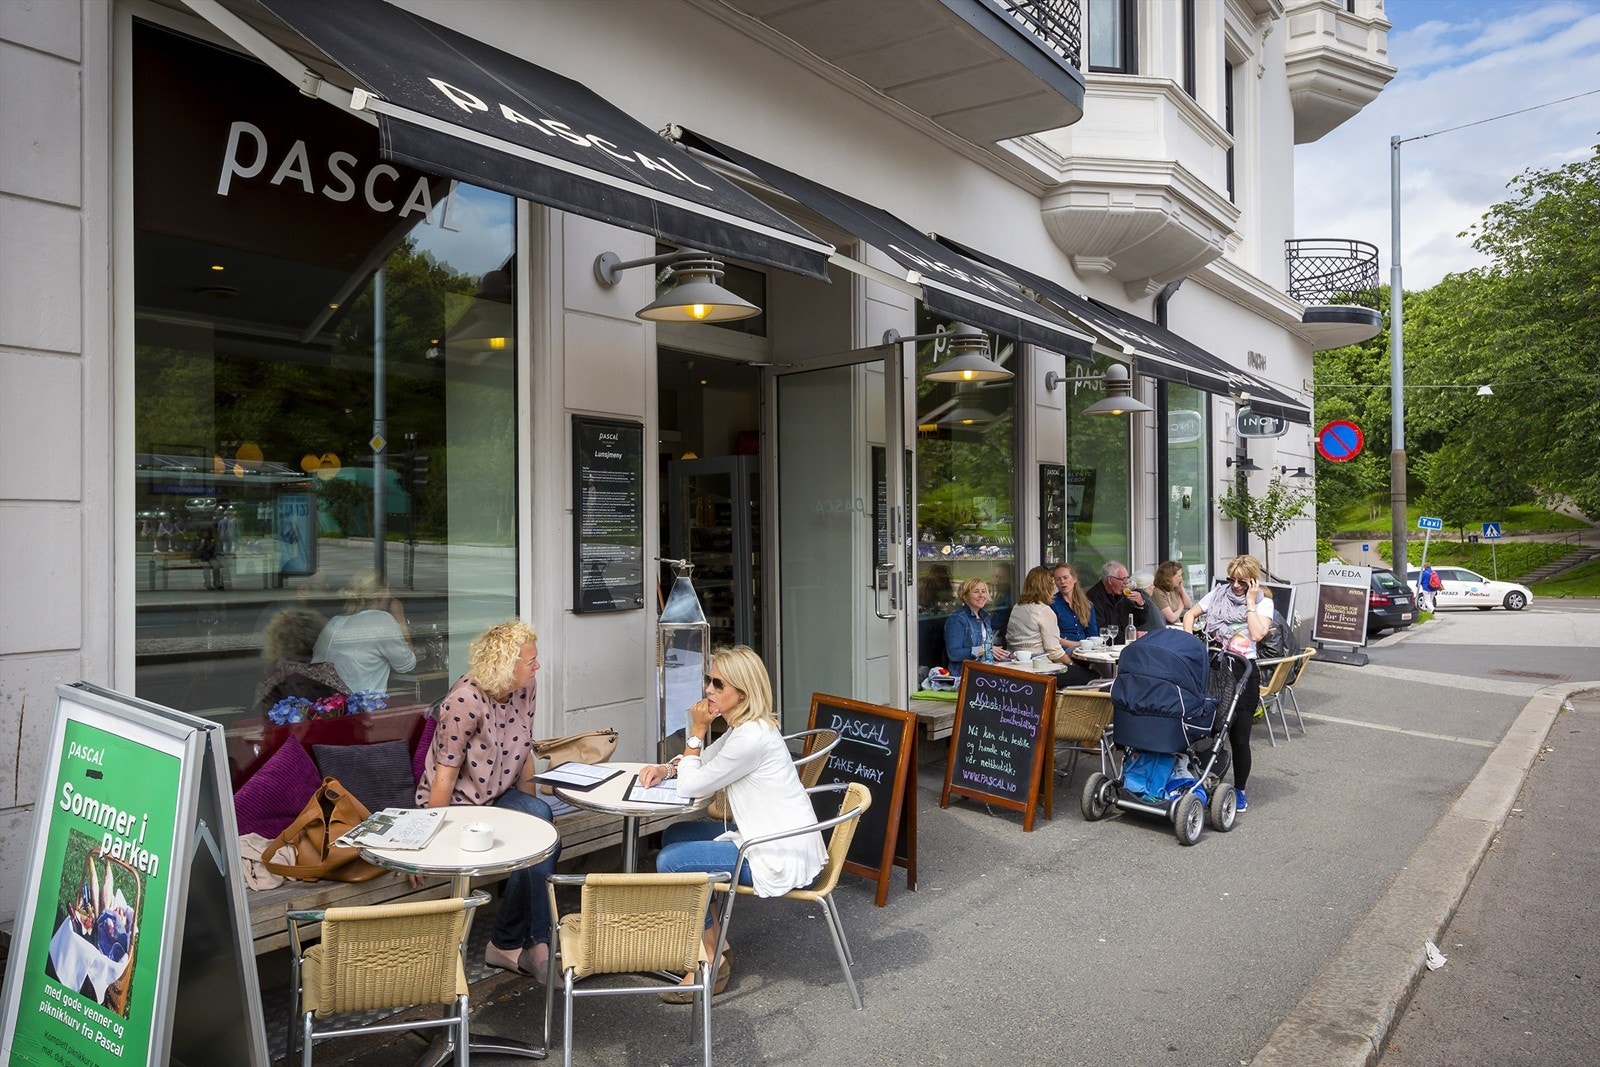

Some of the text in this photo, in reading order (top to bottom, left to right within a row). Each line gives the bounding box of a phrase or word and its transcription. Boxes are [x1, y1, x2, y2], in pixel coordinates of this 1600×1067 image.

[426, 76, 714, 192] PASCAL
[1422, 518, 1440, 528] Taxi
[1327, 569, 1362, 579] AVEDA
[828, 754, 884, 784] TAKE AWAY
[60, 781, 148, 844] Sommer i
[99, 831, 160, 878] parken
[38, 1001, 125, 1058] piknikkurv fra Pascal
[44, 984, 125, 1039] med gode venner og
